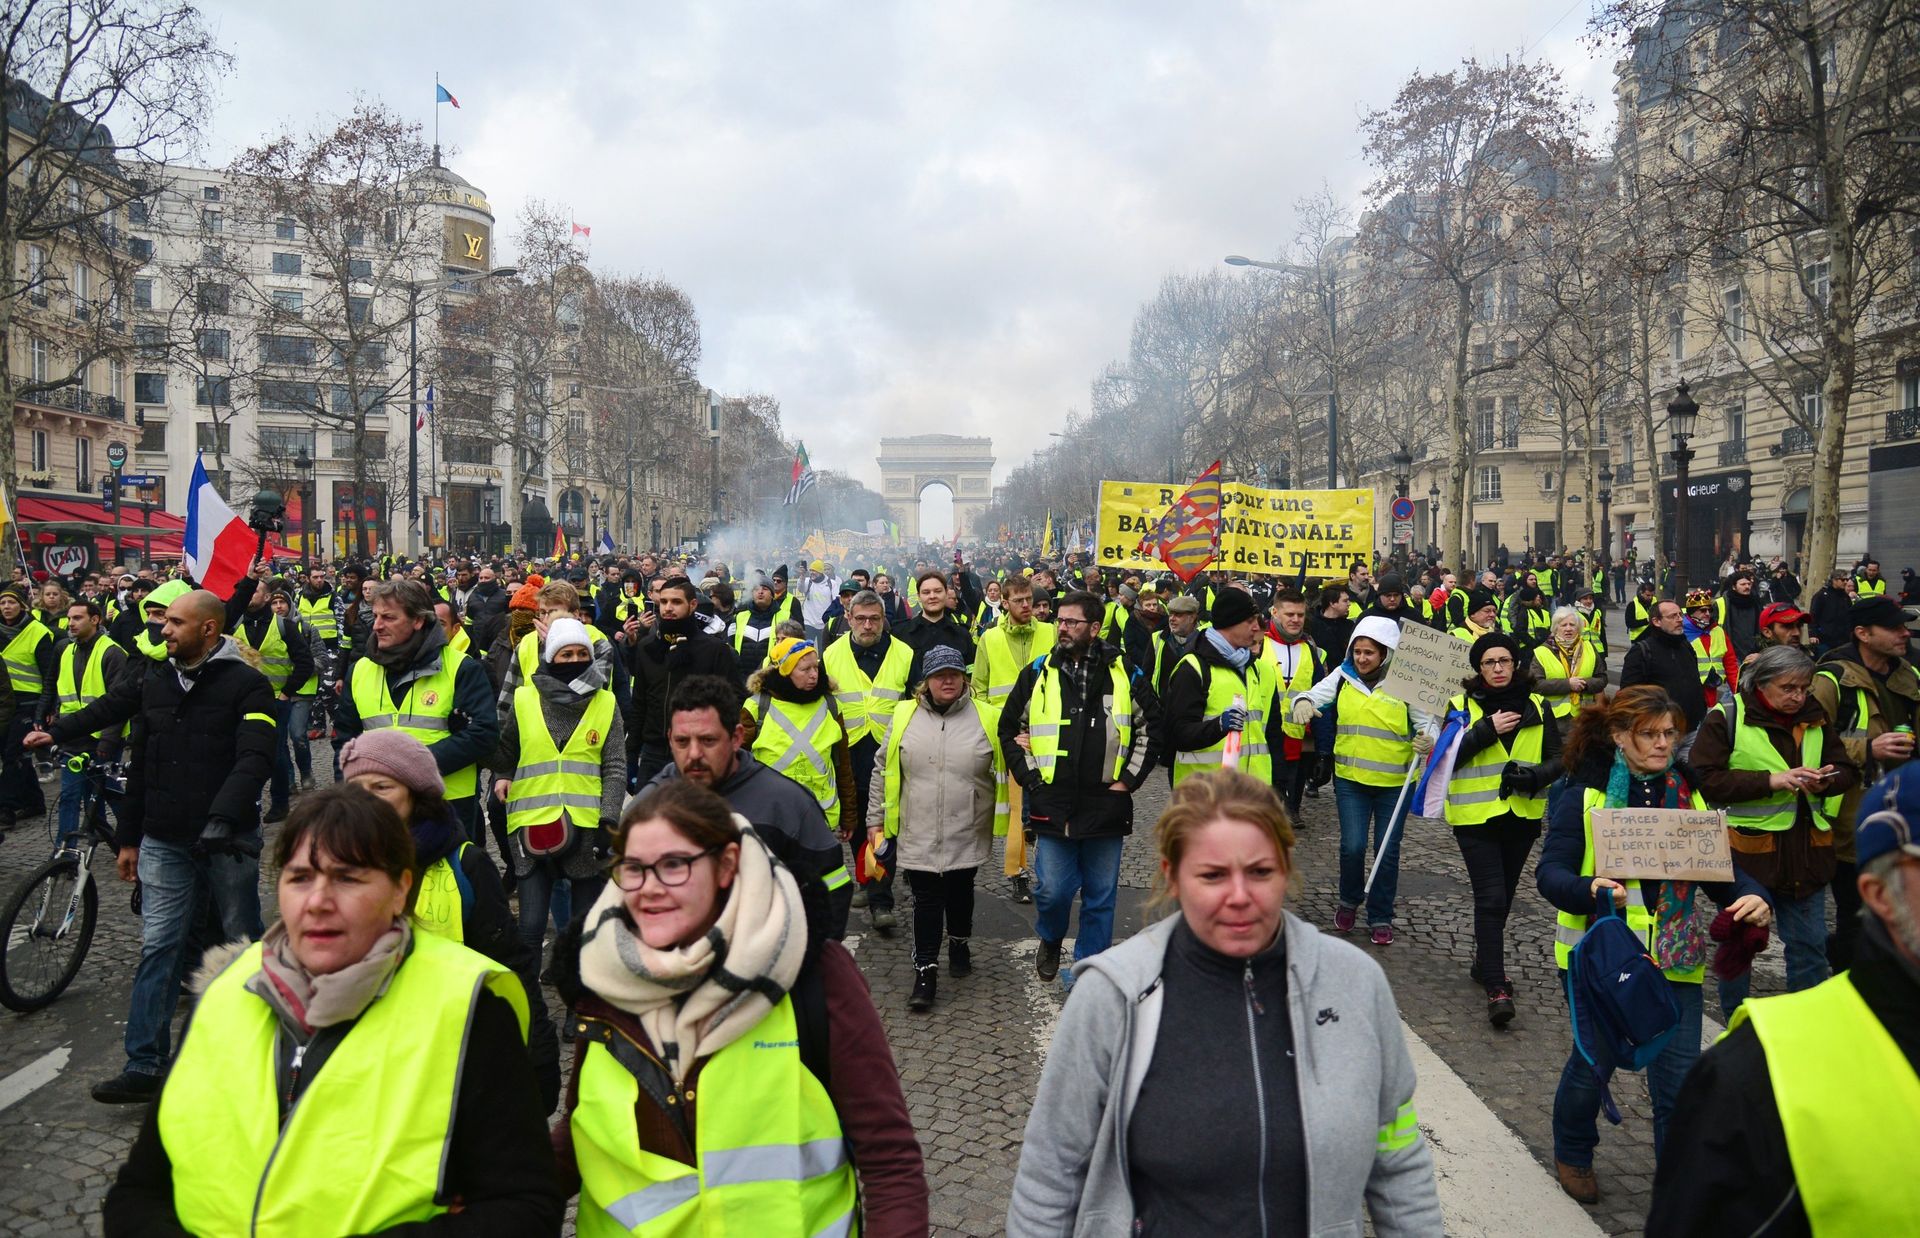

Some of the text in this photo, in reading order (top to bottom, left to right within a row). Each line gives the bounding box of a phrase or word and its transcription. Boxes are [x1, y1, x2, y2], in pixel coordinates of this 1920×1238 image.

[109, 447, 124, 456] BUS
[1220, 491, 1313, 512] pour une
[1220, 516, 1353, 541] NATIONALE
[1103, 545, 1124, 560] et
[1234, 547, 1258, 565] de
[1263, 549, 1283, 567] la
[1398, 641, 1444, 662] CAMPAGNE
[1392, 669, 1456, 697] NOUS PRENDRE
[1601, 828, 1655, 838] CESSEZ
[1677, 827, 1722, 838] COMBAT
[1605, 855, 1624, 868] LE
[1684, 856, 1693, 869] 1
